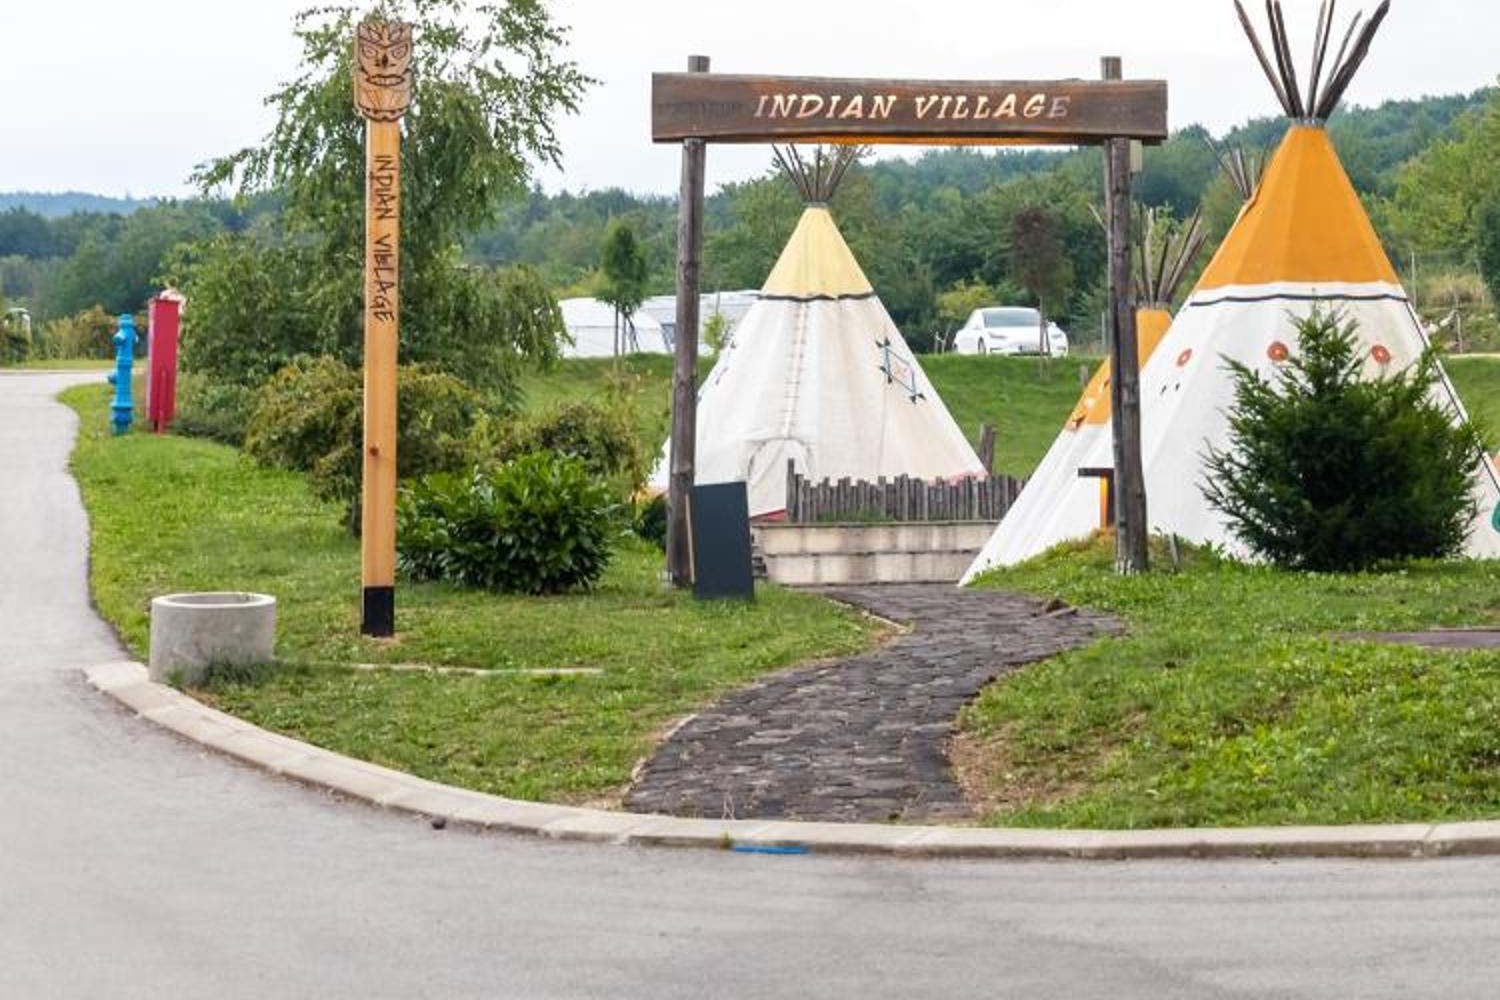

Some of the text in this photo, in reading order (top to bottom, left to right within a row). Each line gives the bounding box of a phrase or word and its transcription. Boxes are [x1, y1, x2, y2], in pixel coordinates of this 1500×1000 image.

[754, 93, 1071, 120] INDIAN VILLAGE
[371, 154, 397, 323] INDIAN VILLAGE
